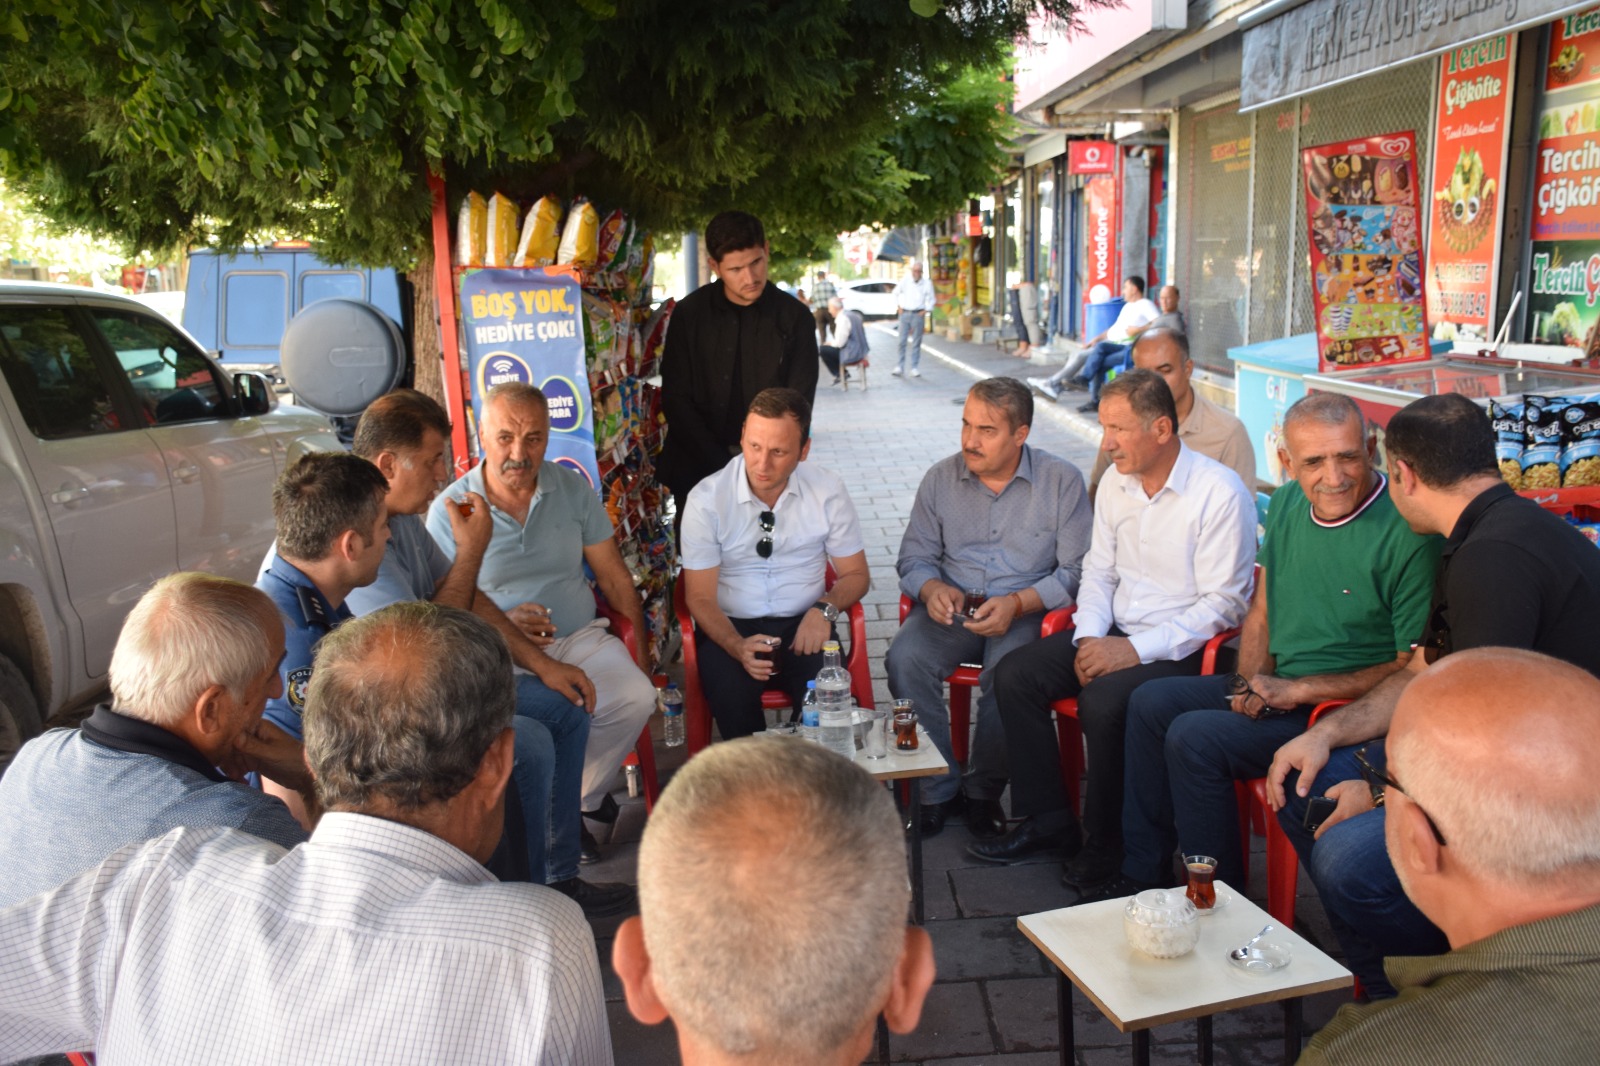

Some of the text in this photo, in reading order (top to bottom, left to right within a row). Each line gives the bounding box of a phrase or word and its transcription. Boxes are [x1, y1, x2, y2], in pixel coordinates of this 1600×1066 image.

[1564, 10, 1600, 37] Terc
[1447, 36, 1506, 74] Tercih
[1445, 75, 1502, 115] Çiğköfte
[1541, 140, 1600, 174] Tercih
[1538, 176, 1600, 216] Çiğköf
[1094, 206, 1109, 280] vodafone
[471, 288, 574, 320] BOŞ YOK,
[475, 320, 576, 344] HEDİYE ÇOK!
[490, 372, 519, 385] HEDİYE
[547, 395, 574, 409] EDİYE
[291, 669, 312, 680] POLİ
